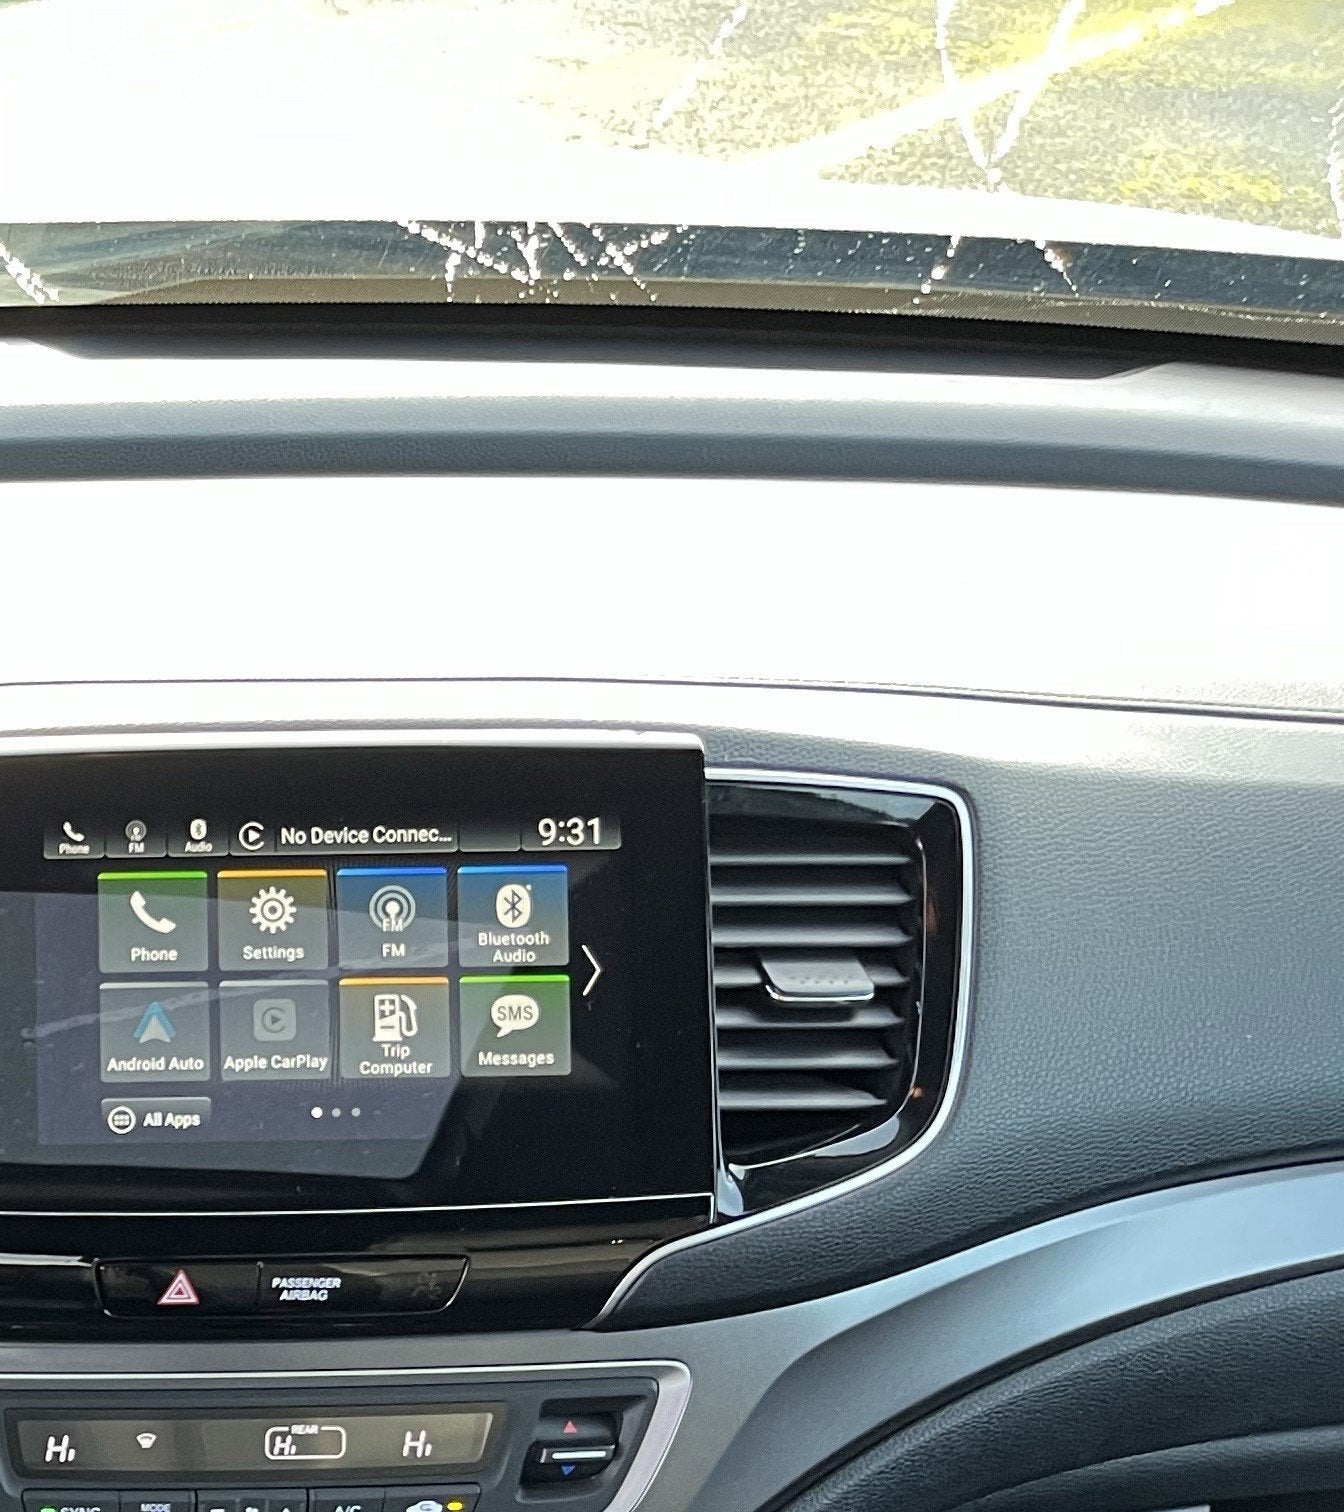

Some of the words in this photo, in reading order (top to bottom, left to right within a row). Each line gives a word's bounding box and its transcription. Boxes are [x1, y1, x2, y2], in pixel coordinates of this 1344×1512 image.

[280, 826, 307, 846] No
[310, 826, 369, 845] Device
[537, 816, 602, 847] 9:31
[58, 842, 91, 855] Phone
[127, 841, 146, 854] FM
[183, 840, 214, 854] Audio
[477, 930, 552, 947] Bluetooth
[129, 945, 179, 963] Phone
[241, 944, 306, 963] Settings
[381, 942, 406, 958] FM
[492, 949, 537, 964] Audio
[496, 1003, 535, 1023] SMS
[380, 1042, 412, 1061] Trip
[477, 1050, 556, 1068] Messages
[106, 1055, 166, 1073] Android
[167, 1055, 206, 1072] Auto
[222, 1054, 268, 1073] Apple
[270, 1053, 329, 1072] CarPlay
[358, 1060, 434, 1078] Computer
[141, 1110, 163, 1128] All
[163, 1110, 202, 1130] Apps
[270, 1275, 343, 1291] PASSENGER
[278, 1288, 330, 1302] AIRBAG
[290, 1423, 319, 1435] REAR
[139, 1502, 172, 1512] MODE
